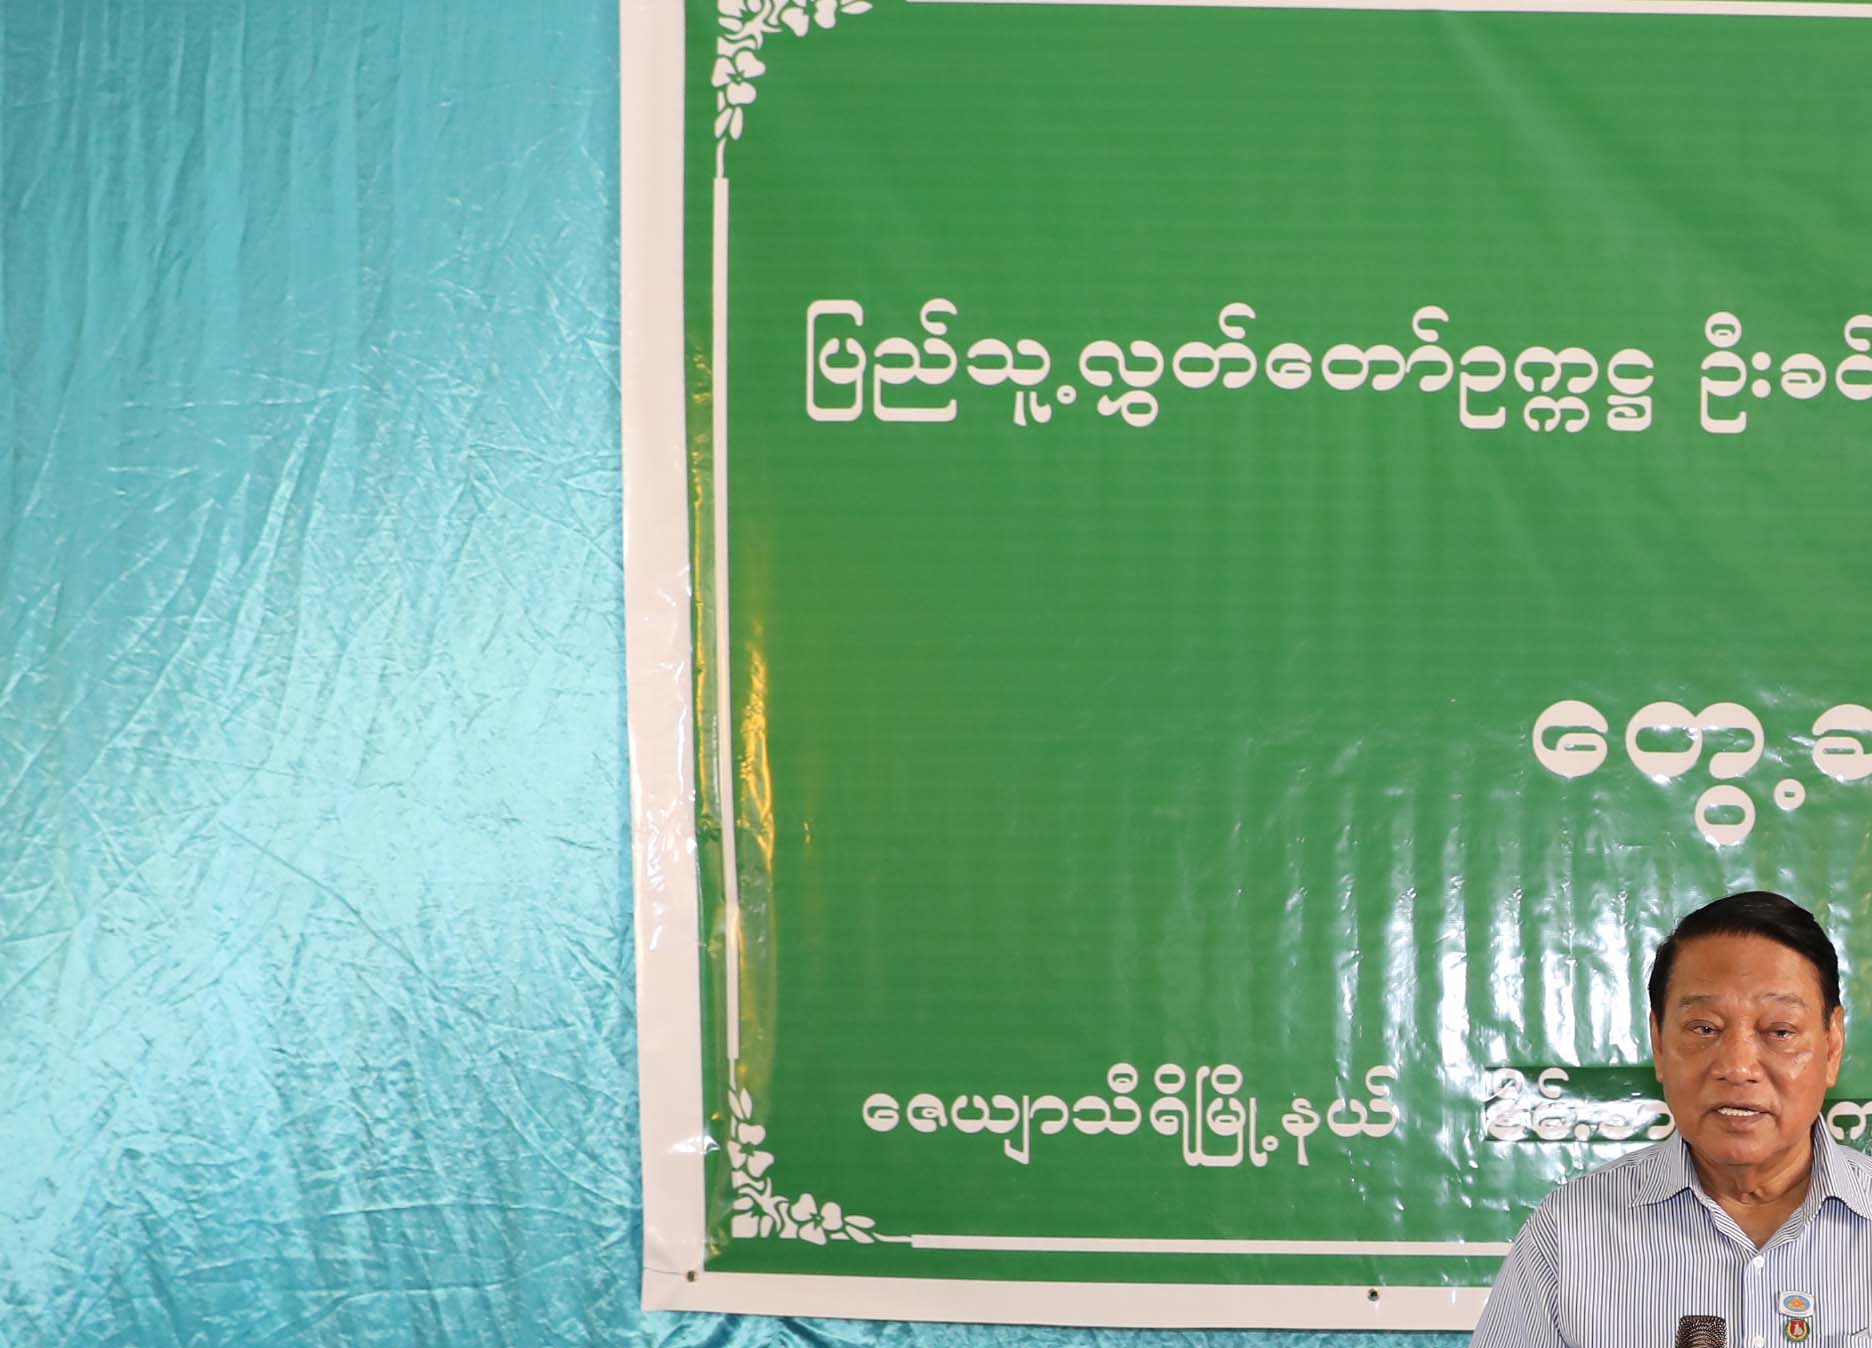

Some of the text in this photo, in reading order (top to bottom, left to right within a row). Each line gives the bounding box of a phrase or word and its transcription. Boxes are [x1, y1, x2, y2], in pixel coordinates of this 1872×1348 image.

[862, 1062, 1399, 1168] ဇေယျာသီရိမြို့နယ်
